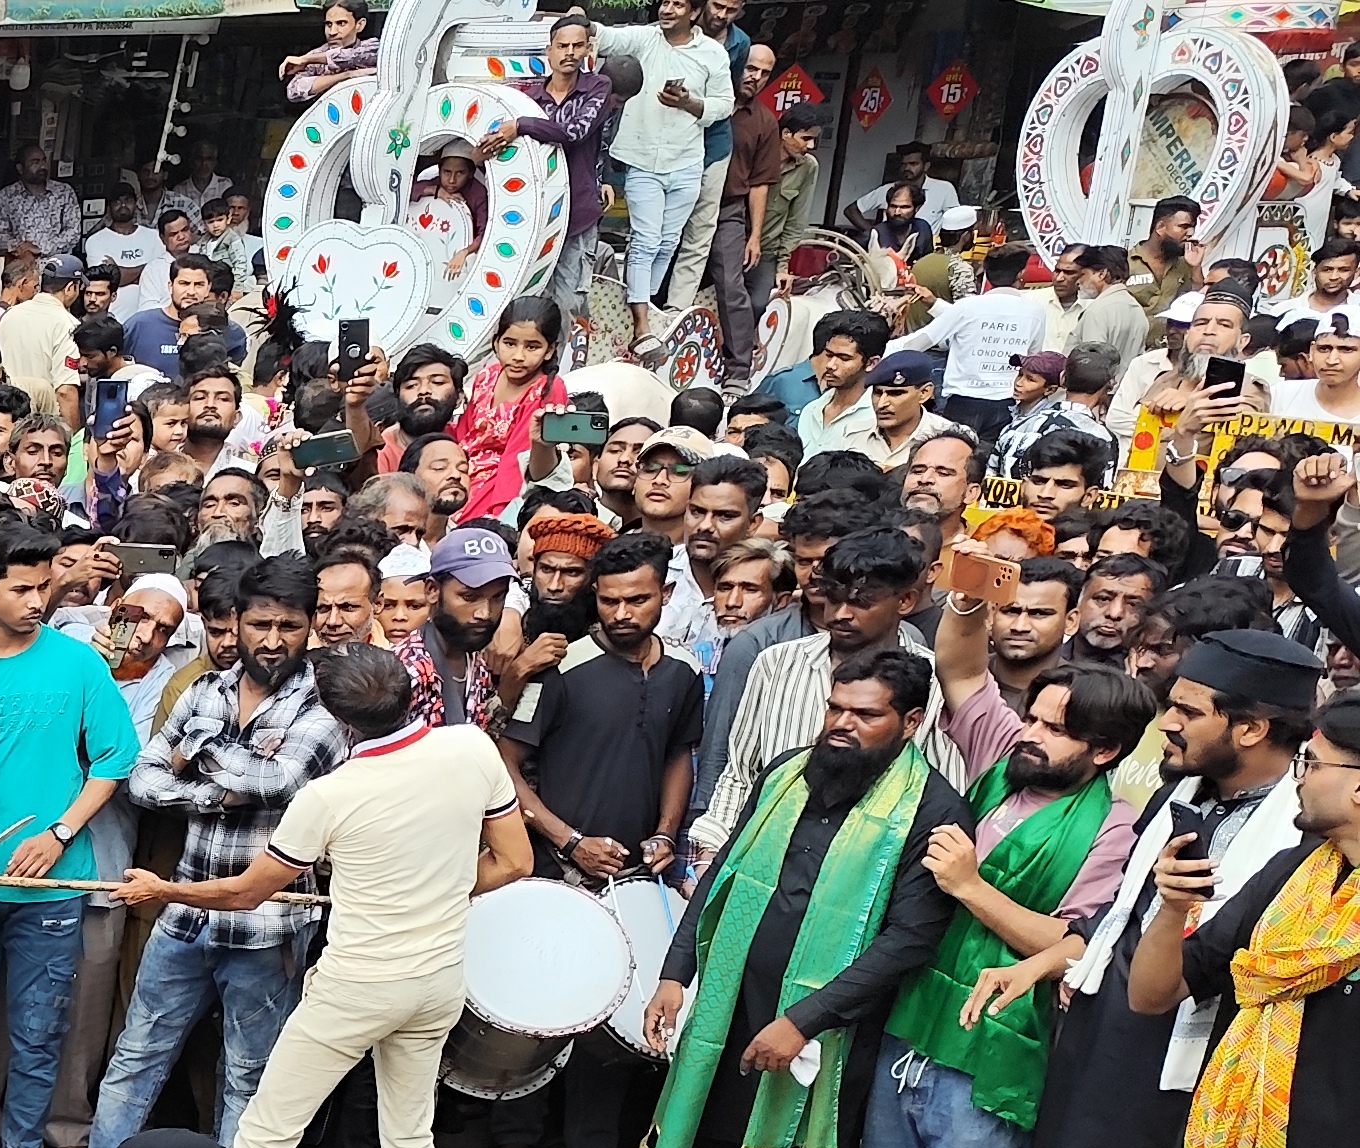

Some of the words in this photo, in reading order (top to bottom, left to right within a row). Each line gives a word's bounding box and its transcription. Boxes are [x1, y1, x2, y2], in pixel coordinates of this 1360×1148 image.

[1149, 112, 1204, 190] MPERIA
[981, 321, 1018, 332] PARIS
[982, 336, 1001, 344] NEW
[1003, 338, 1029, 346] YORK
[971, 349, 1012, 358] LONDON
[464, 536, 506, 556] BOY
[1110, 756, 1165, 791] Neve
